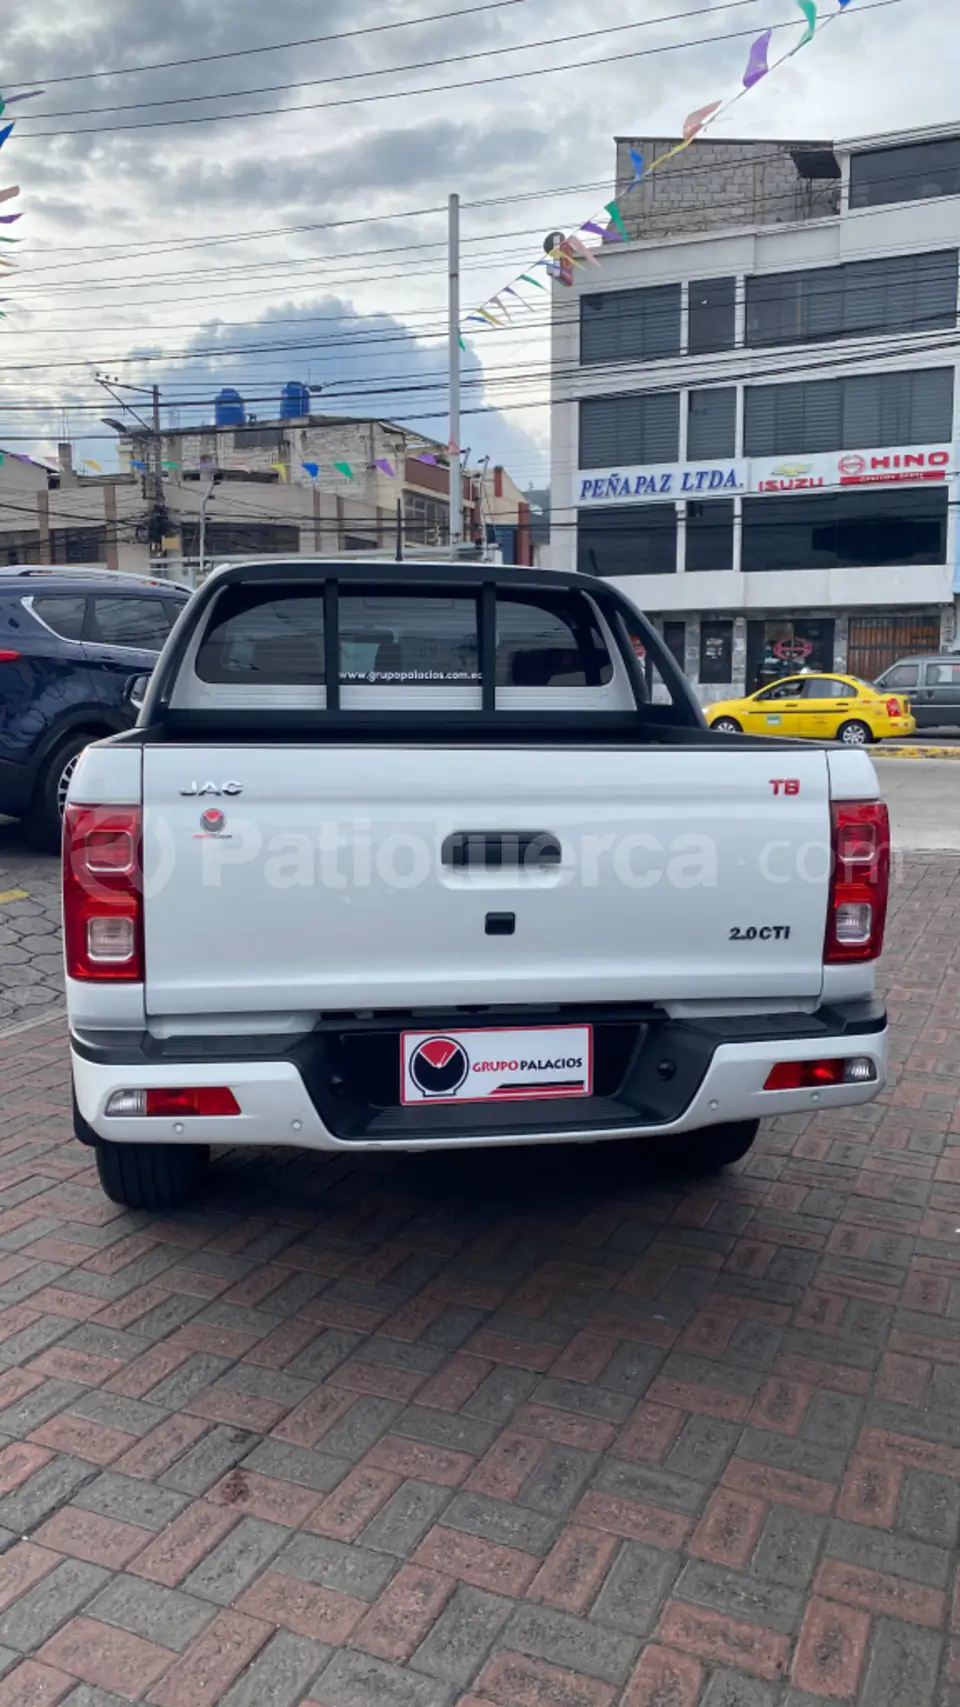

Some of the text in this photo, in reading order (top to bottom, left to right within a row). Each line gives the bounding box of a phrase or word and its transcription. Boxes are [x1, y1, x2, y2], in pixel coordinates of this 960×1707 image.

[870, 451, 949, 470] HINO
[680, 468, 745, 492] LTDA.
[758, 477, 824, 492] ISUZU
[178, 780, 243, 797] JAC
